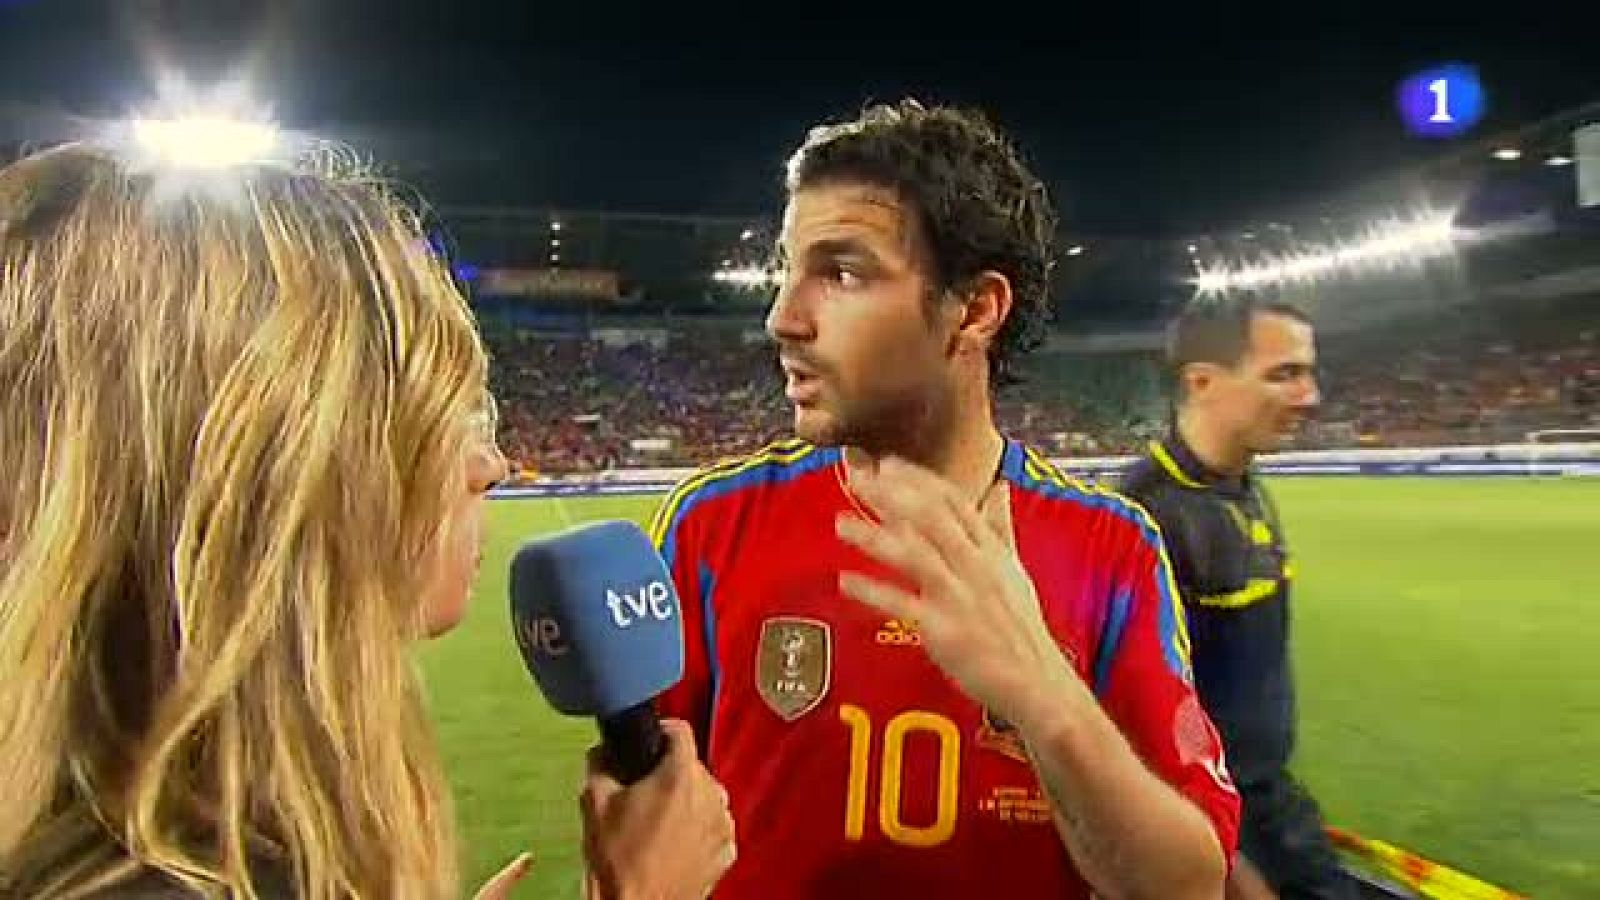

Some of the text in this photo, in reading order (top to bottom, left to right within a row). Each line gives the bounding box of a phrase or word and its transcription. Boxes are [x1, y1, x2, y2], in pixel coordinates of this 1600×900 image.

[605, 579, 673, 627] tve
[518, 618, 569, 656] ve
[839, 704, 961, 846] 10
